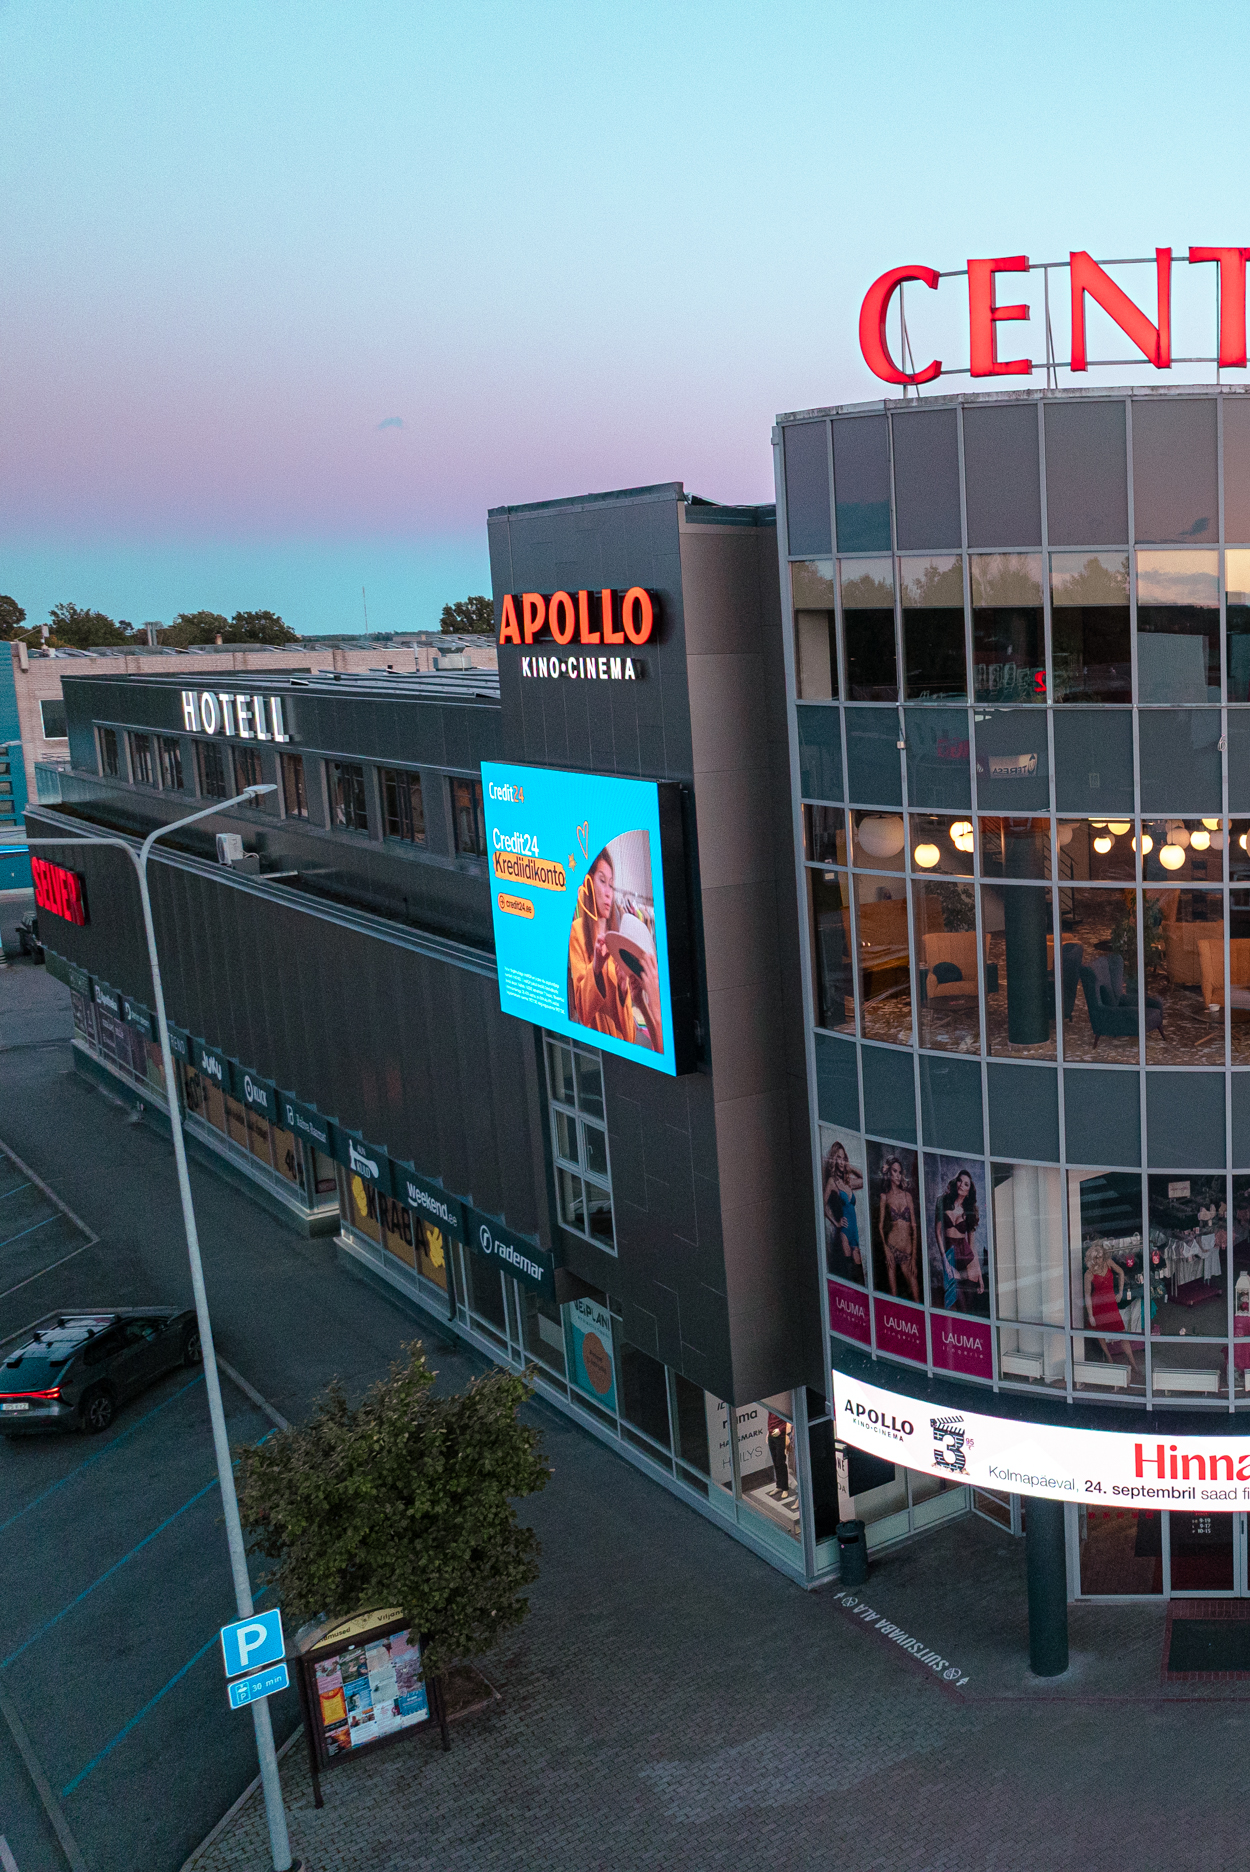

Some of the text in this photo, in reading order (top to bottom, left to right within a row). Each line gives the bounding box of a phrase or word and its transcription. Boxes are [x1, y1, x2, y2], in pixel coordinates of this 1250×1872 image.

[499, 586, 654, 646] APOLLO
[182, 690, 290, 742] HOTELL
[489, 782, 525, 803] Credit24
[493, 828, 540, 857] Credit24
[494, 852, 565, 888] Krediidikonto
[32, 856, 85, 927] SELVER
[506, 900, 532, 914] credit24.ee
[365, 1182, 429, 1259] KRABA
[406, 1181, 458, 1228] weekend.ee
[494, 1240, 544, 1281] rademar
[836, 1296, 865, 1318] LAUMA
[884, 1315, 919, 1336] LAUMA
[942, 1331, 982, 1351] LAUMA
[845, 1399, 914, 1435] APOLLO
[720, 1428, 763, 1449] HASMARK
[722, 1446, 763, 1469] HILYS
[988, 1465, 1079, 1493] Kolmapäeval,
[1084, 1480, 1107, 1495] 24.
[1112, 1484, 1196, 1500] septembril
[1201, 1487, 1238, 1501] saad
[852, 1603, 880, 1621] ALA
[237, 1623, 268, 1667] P
[874, 1618, 949, 1671] SUITSUVABA
[252, 1683, 262, 1692] 30
[266, 1676, 282, 1687] min
